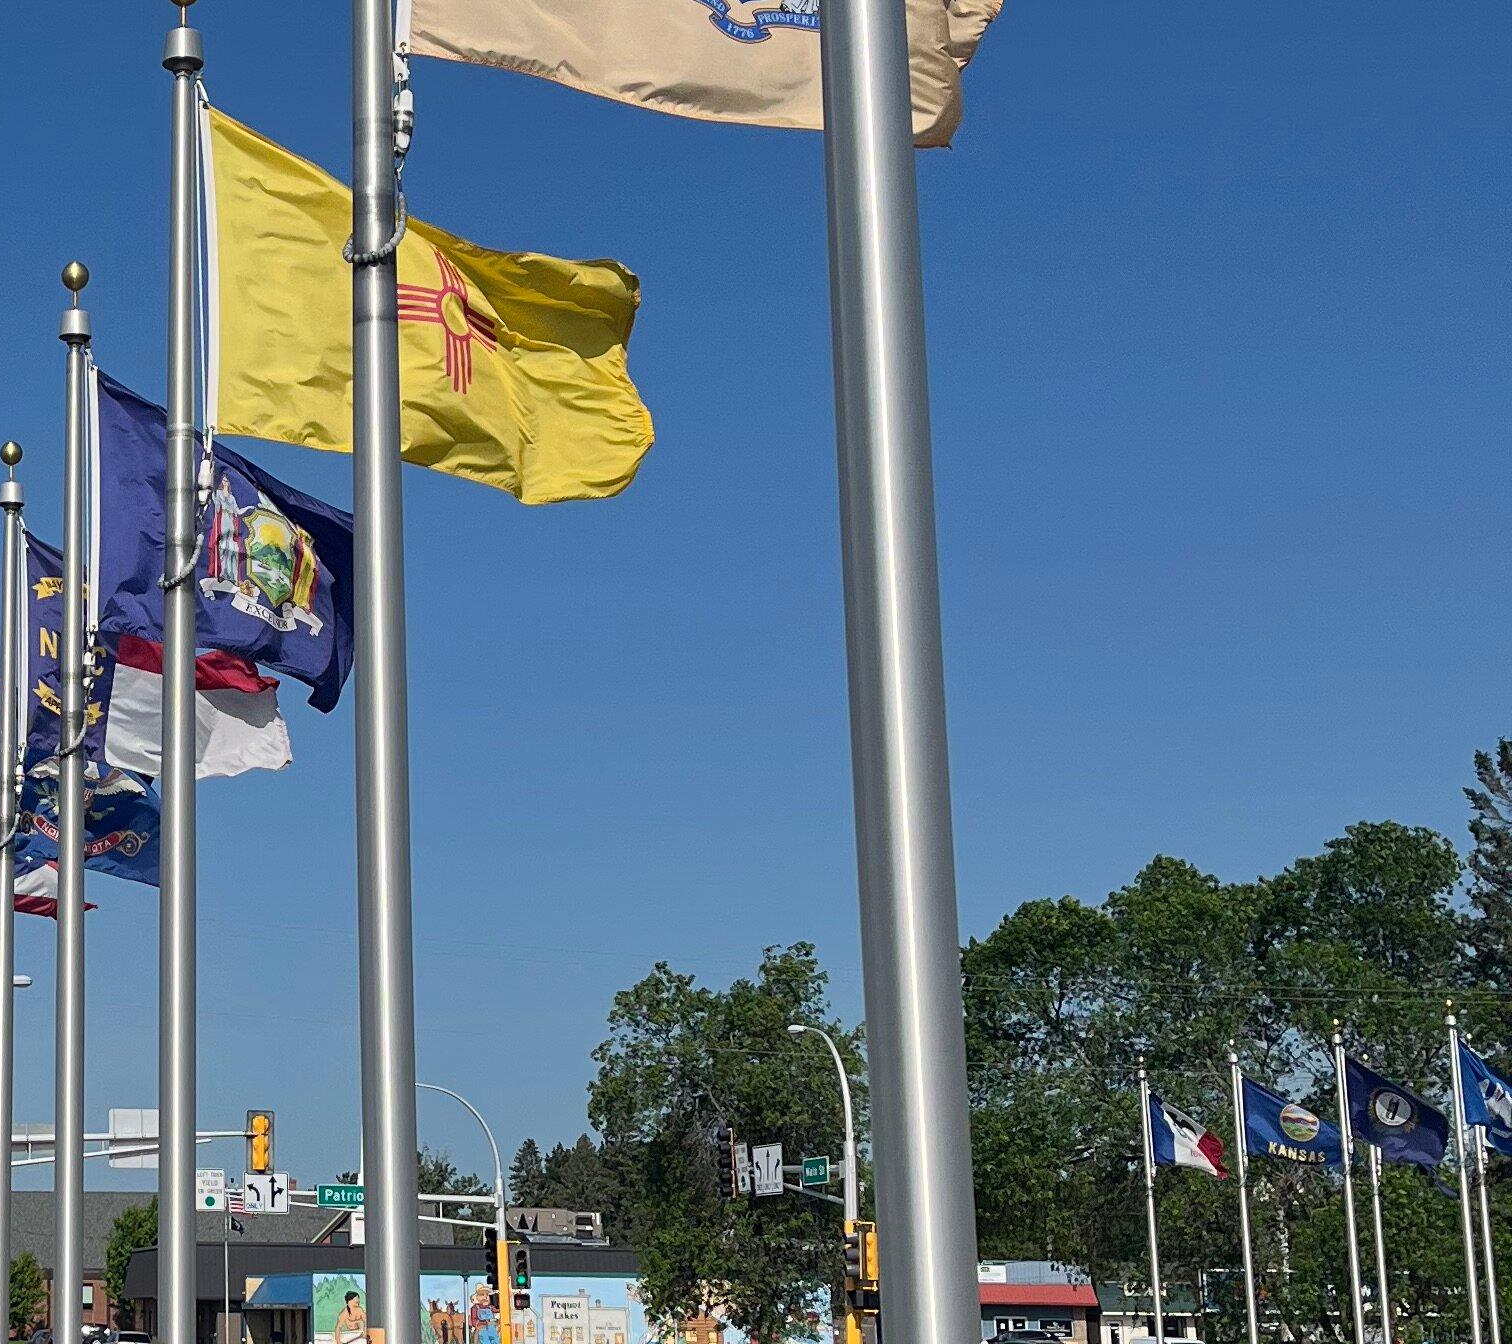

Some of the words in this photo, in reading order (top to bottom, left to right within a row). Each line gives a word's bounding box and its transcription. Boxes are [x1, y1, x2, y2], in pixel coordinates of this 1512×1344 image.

[758, 13, 820, 27] PROSPERI
[727, 23, 755, 39] 1776
[40, 627, 58, 659] N
[1269, 1141, 1326, 1163] KANSAS
[325, 1189, 365, 1202] Patrio
[551, 1300, 581, 1310] Pequot
[554, 1312, 579, 1320] Lakes
